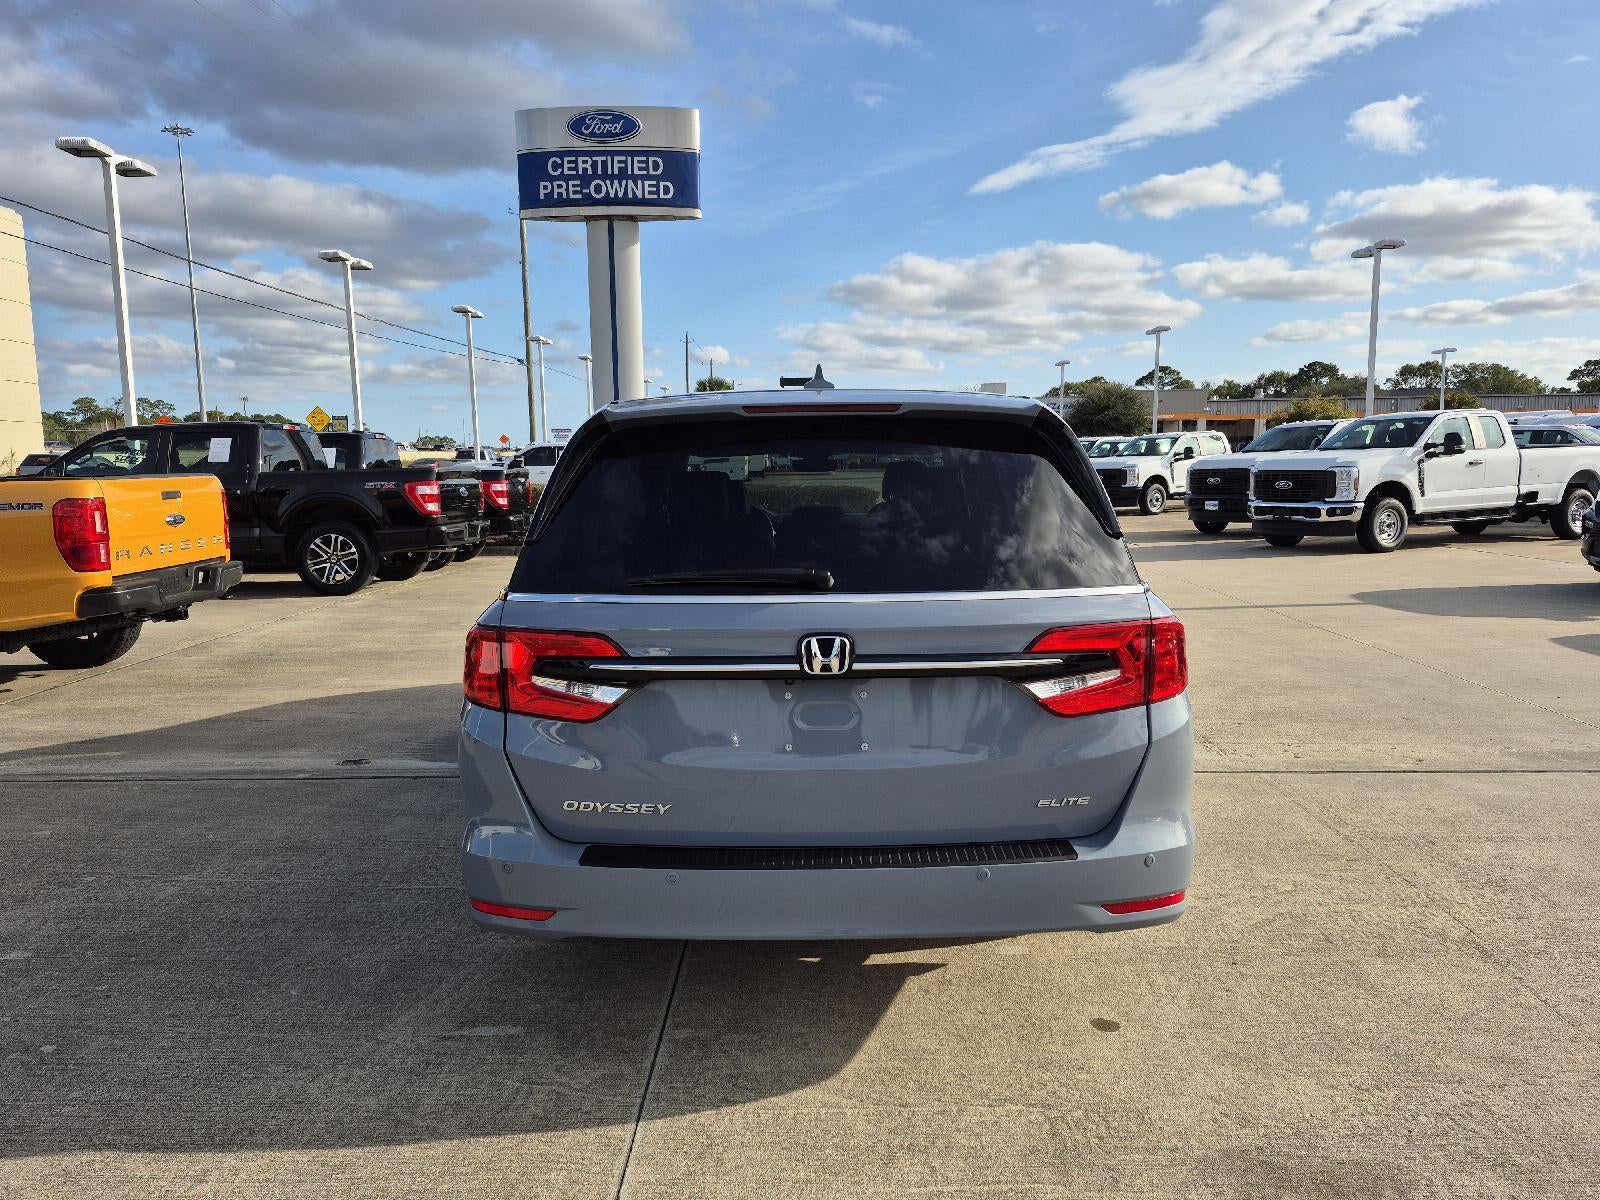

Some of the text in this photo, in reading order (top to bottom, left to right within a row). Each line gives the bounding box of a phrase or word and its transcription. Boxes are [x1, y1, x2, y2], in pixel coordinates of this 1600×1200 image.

[581, 114, 624, 134] Ford
[547, 156, 664, 176] CERTIFIED
[539, 180, 674, 200] PRE-OWNED
[115, 535, 223, 561] RANGER
[562, 800, 673, 815] ODYSSEY
[1037, 796, 1091, 808] ELITE
